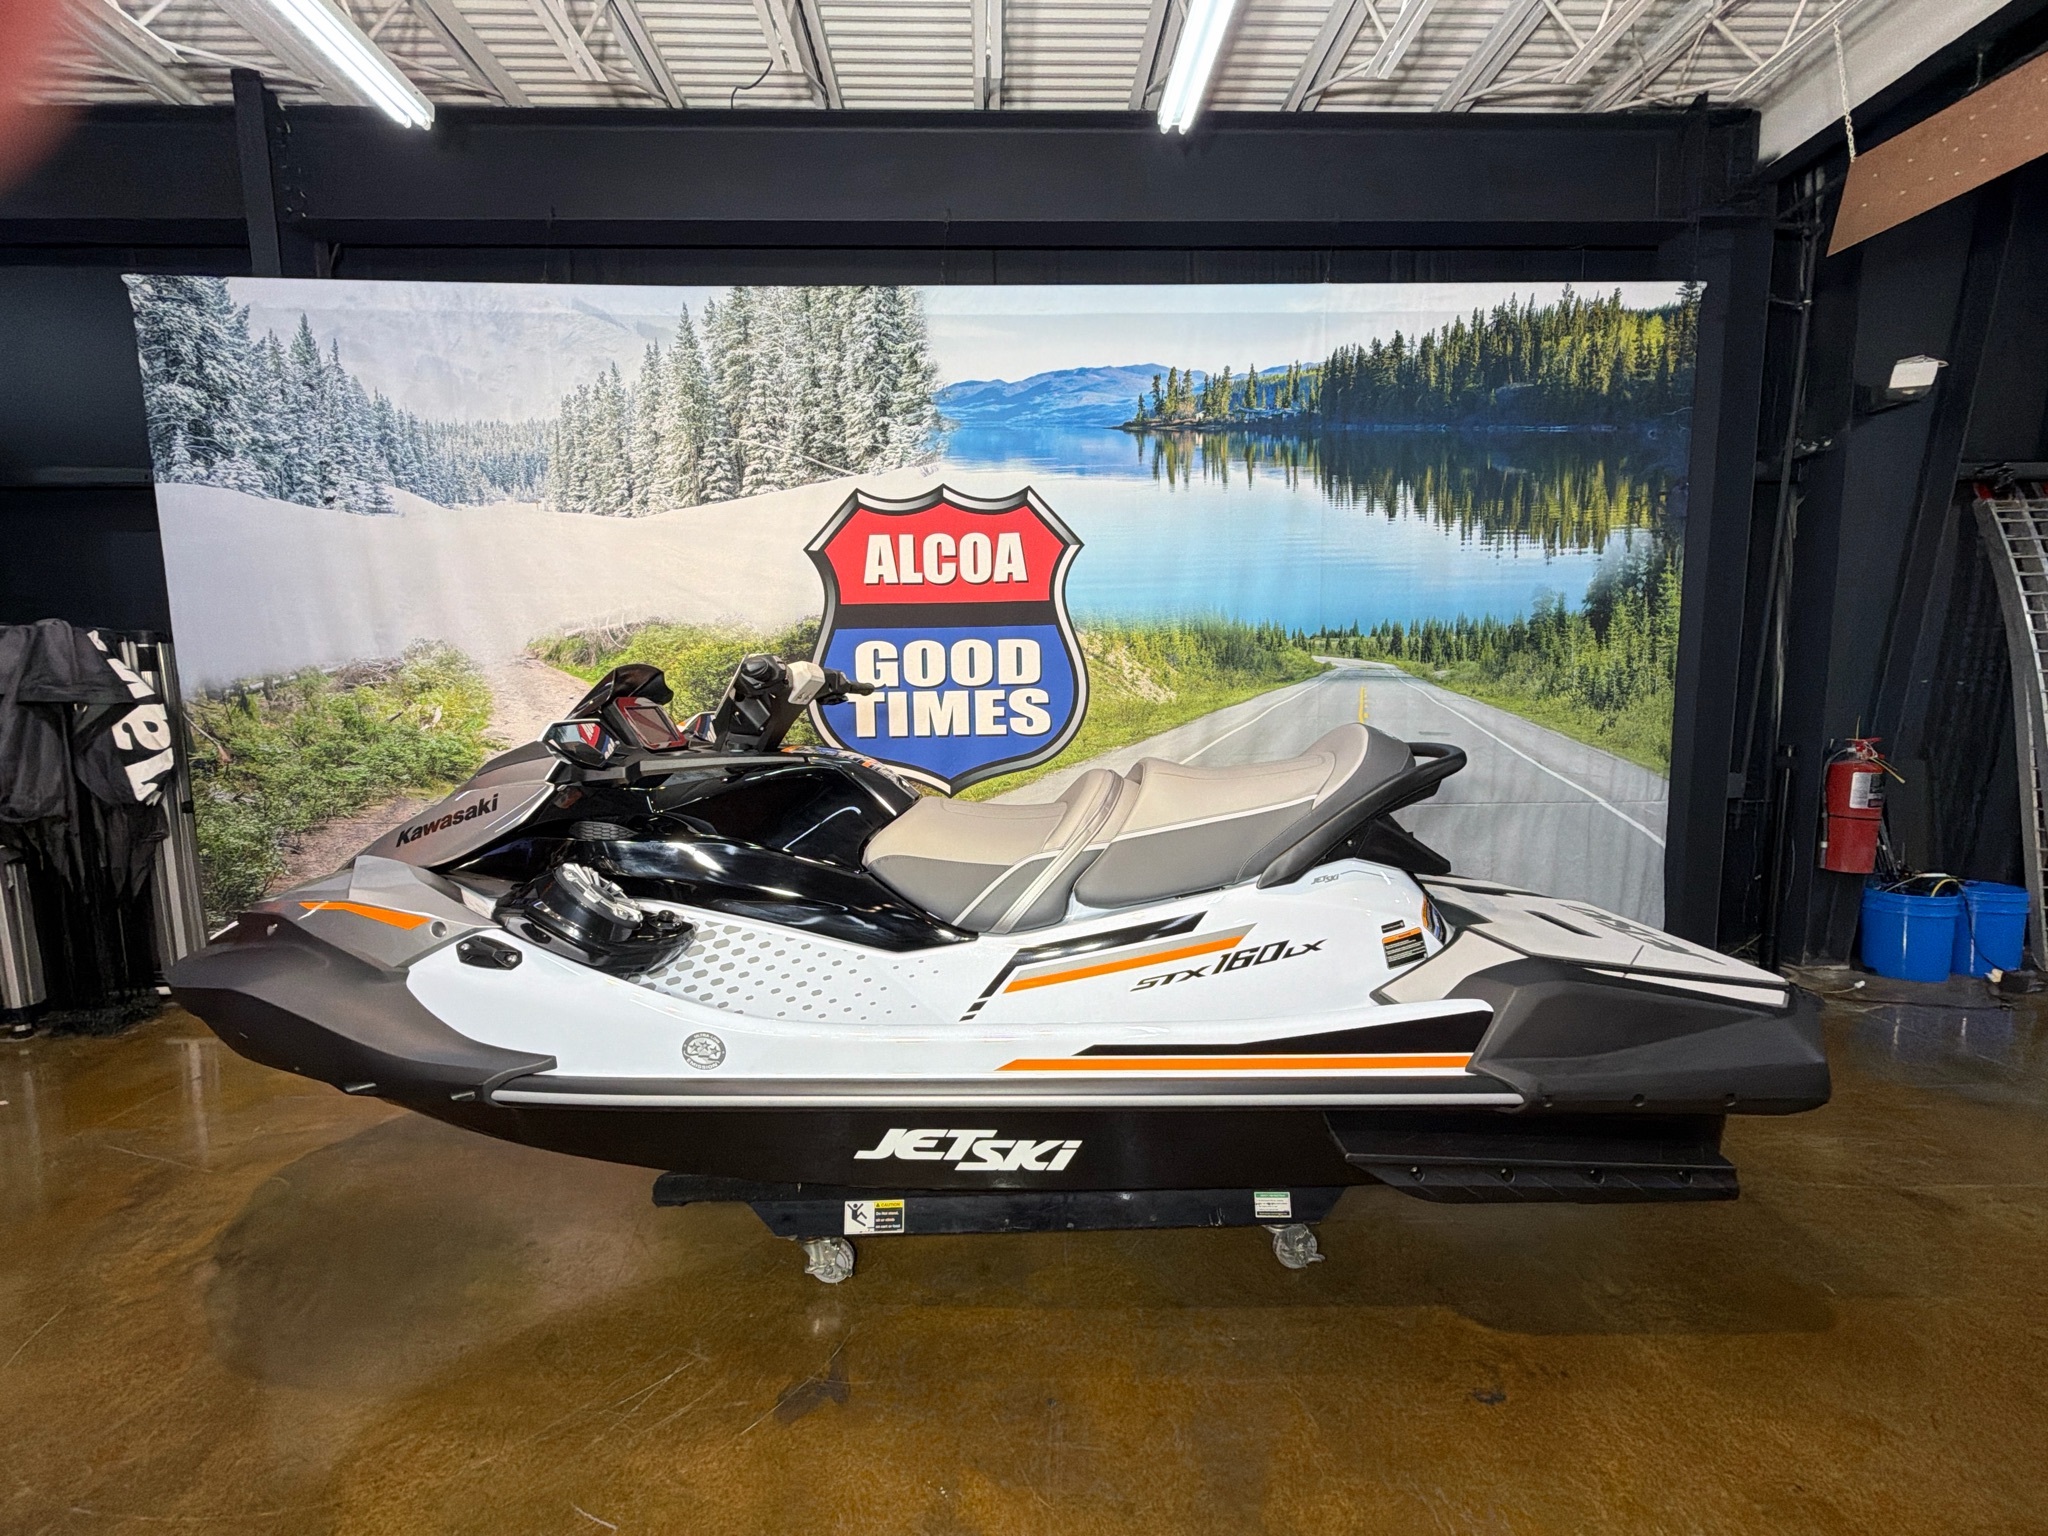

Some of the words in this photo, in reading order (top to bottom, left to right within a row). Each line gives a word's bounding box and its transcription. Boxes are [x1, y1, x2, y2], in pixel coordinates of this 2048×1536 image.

[864, 532, 1028, 585] ALCOA
[855, 638, 1042, 688] GOOD
[848, 688, 1051, 738] TIMES
[396, 793, 499, 848] Kawasaki
